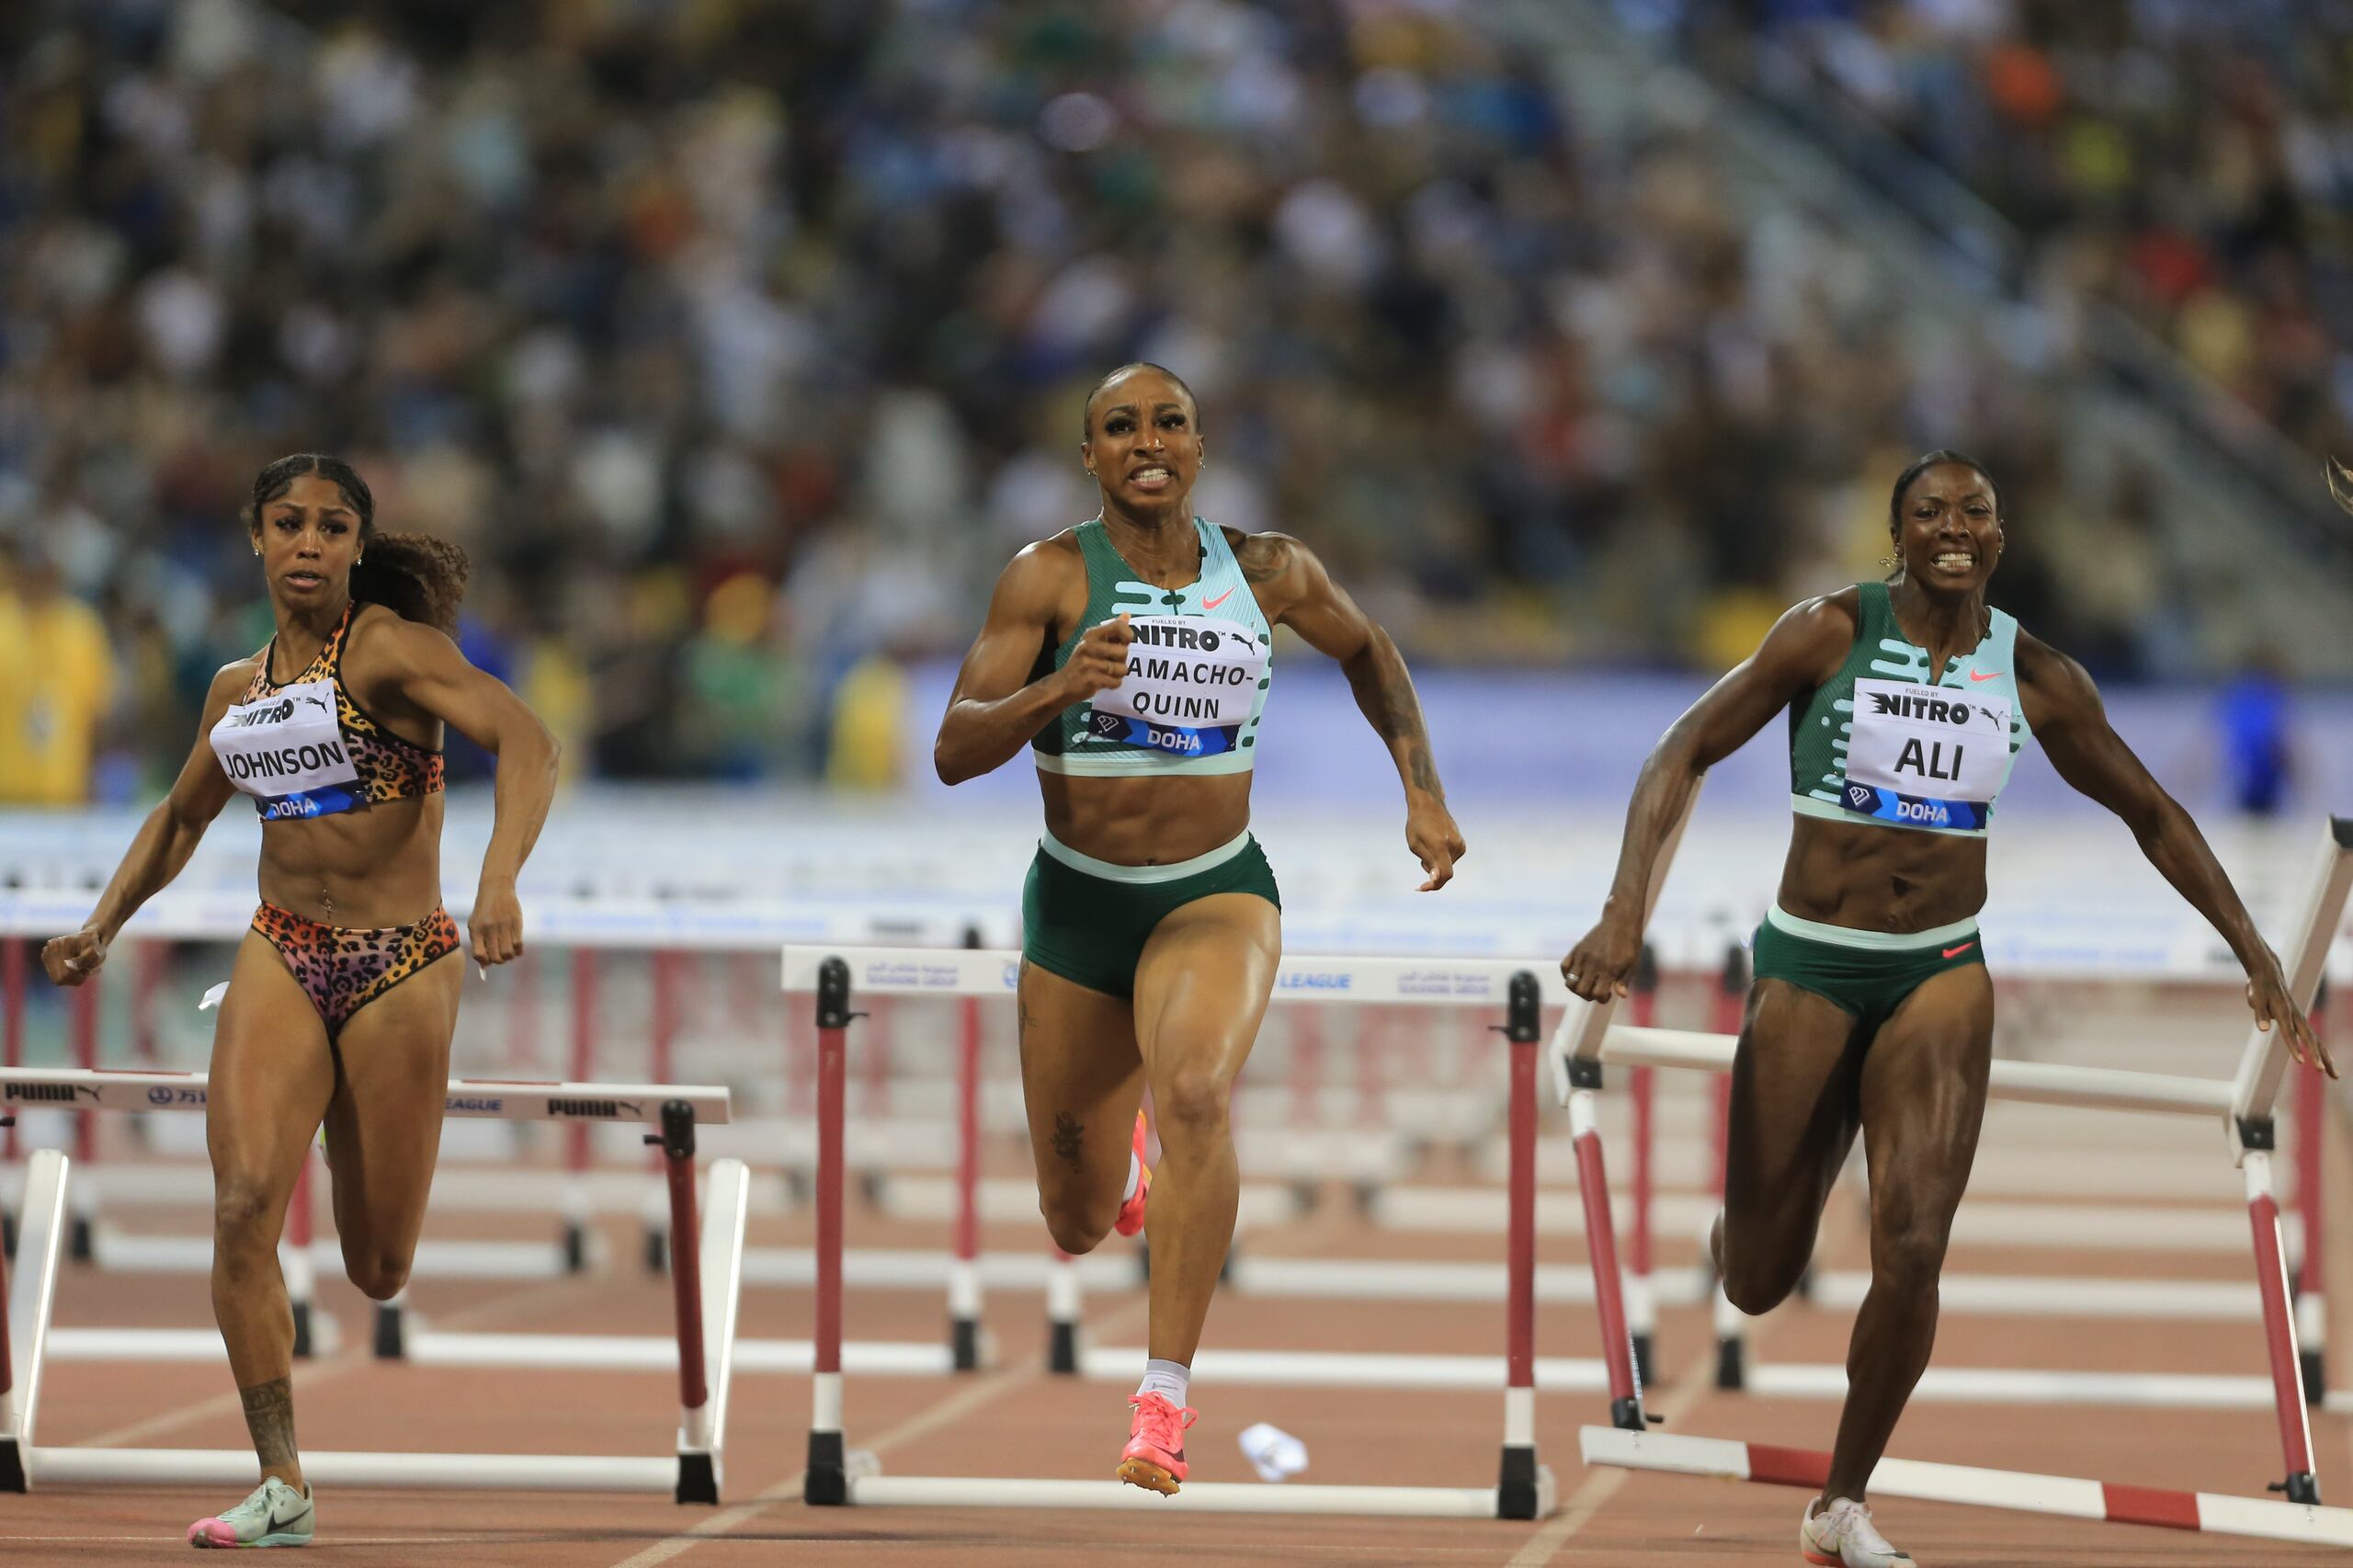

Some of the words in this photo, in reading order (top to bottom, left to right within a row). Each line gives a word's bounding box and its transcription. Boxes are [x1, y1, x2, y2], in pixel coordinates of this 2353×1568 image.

[1127, 656, 1254, 686] AMACHO-
[1905, 687, 1929, 697] FUELED
[1132, 691, 1220, 720] QUINN
[1147, 729, 1200, 750] DOHA
[225, 741, 345, 779] JOHNSON
[1893, 737, 1963, 781] ALI
[273, 798, 317, 817] DOHA
[1896, 801, 1949, 823] DOHA
[1280, 973, 1352, 989] LEAGUE
[6, 1083, 75, 1101] PUMA
[445, 1098, 502, 1111] EAGUE
[547, 1098, 619, 1117] PUMA
